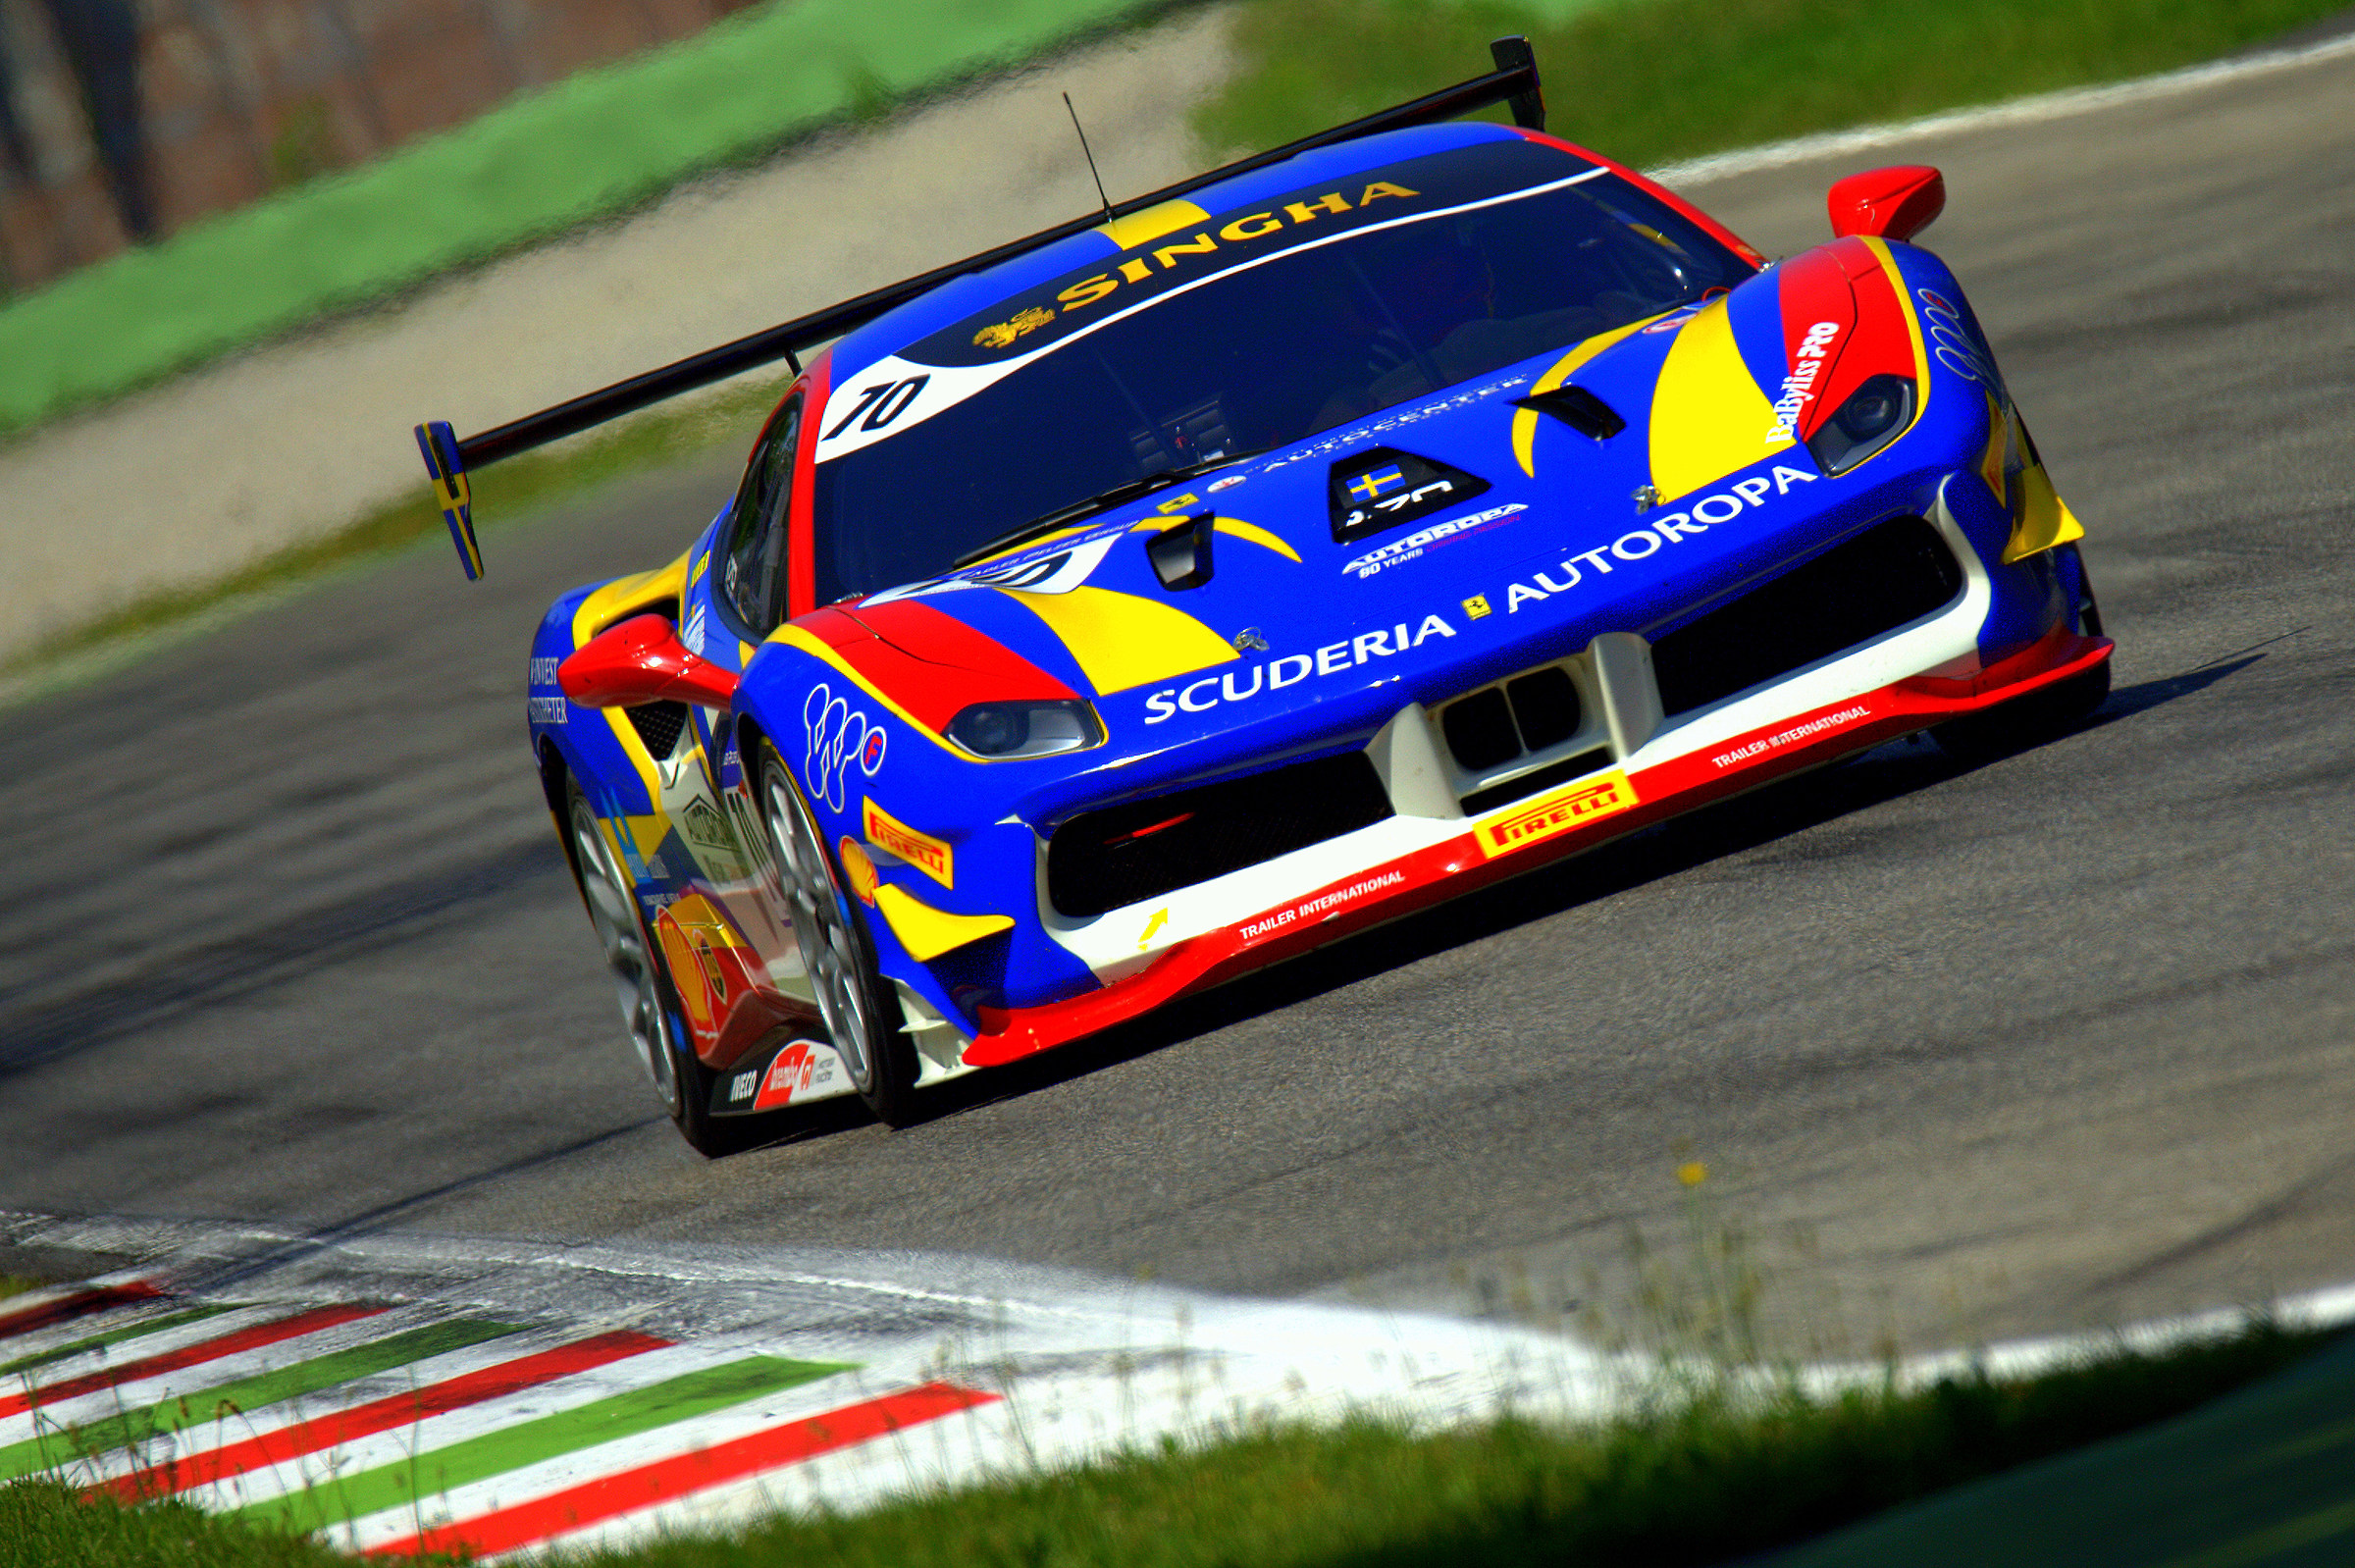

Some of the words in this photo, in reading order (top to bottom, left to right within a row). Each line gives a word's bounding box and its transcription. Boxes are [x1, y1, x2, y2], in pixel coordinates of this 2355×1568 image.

[1057, 182, 1421, 312] SINGHA
[820, 373, 931, 443] 70
[1765, 359, 1822, 444] BaByliss
[1796, 321, 1840, 358] PRO
[1341, 503, 1529, 575] AUTOROPA
[1383, 548, 1424, 568] YEARS
[1145, 614, 1456, 724] SCUDERIA
[1508, 464, 1818, 613] AUTOROPA
[1711, 739, 1770, 769] TRAILER
[1770, 706, 1871, 747] INTERNATIONAL
[869, 811, 945, 874] PIRELLI
[1489, 782, 1621, 848] PIRELLI
[1239, 910, 1297, 940] TRAILER
[1299, 870, 1406, 917] INTERNATIONAL
